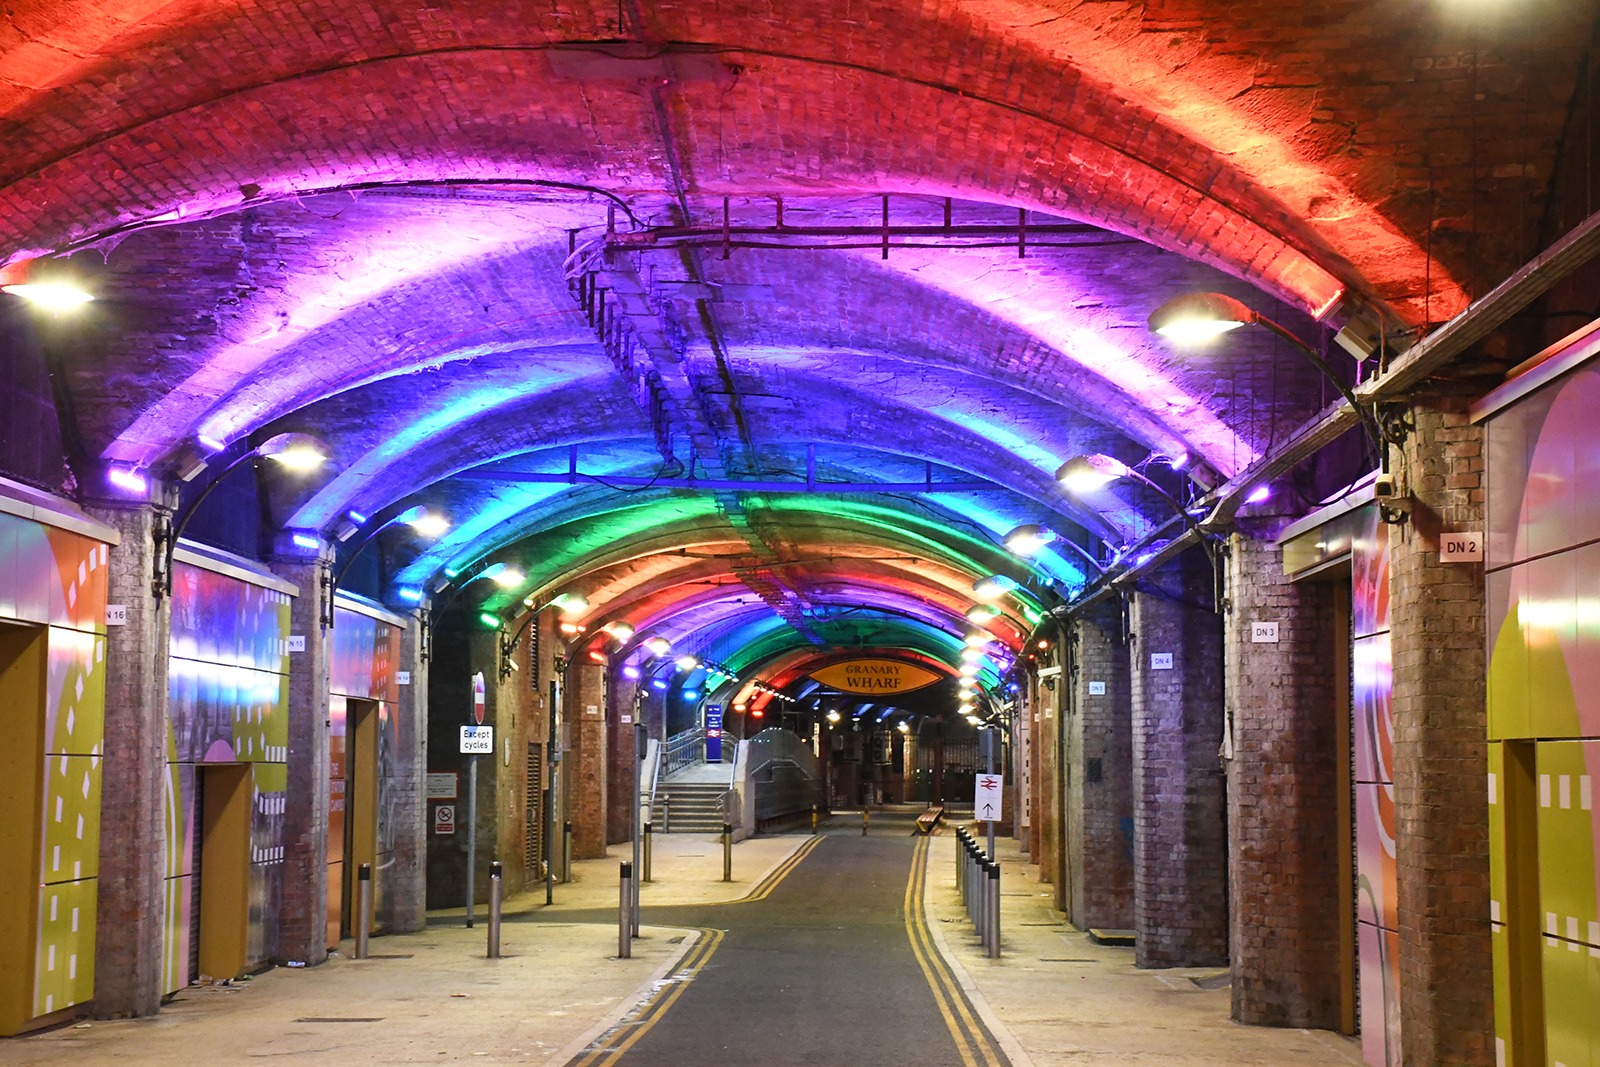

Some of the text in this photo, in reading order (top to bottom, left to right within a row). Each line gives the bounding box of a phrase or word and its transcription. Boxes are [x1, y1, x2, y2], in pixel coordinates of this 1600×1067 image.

[1448, 541, 1476, 553] DN 2
[114, 611, 124, 619] 16
[1256, 628, 1275, 637] DN 3
[1154, 657, 1164, 665] DN
[846, 666, 900, 674] GRANARY
[847, 677, 901, 688] WHARF
[464, 729, 490, 739] Except
[464, 741, 488, 750] cycles
